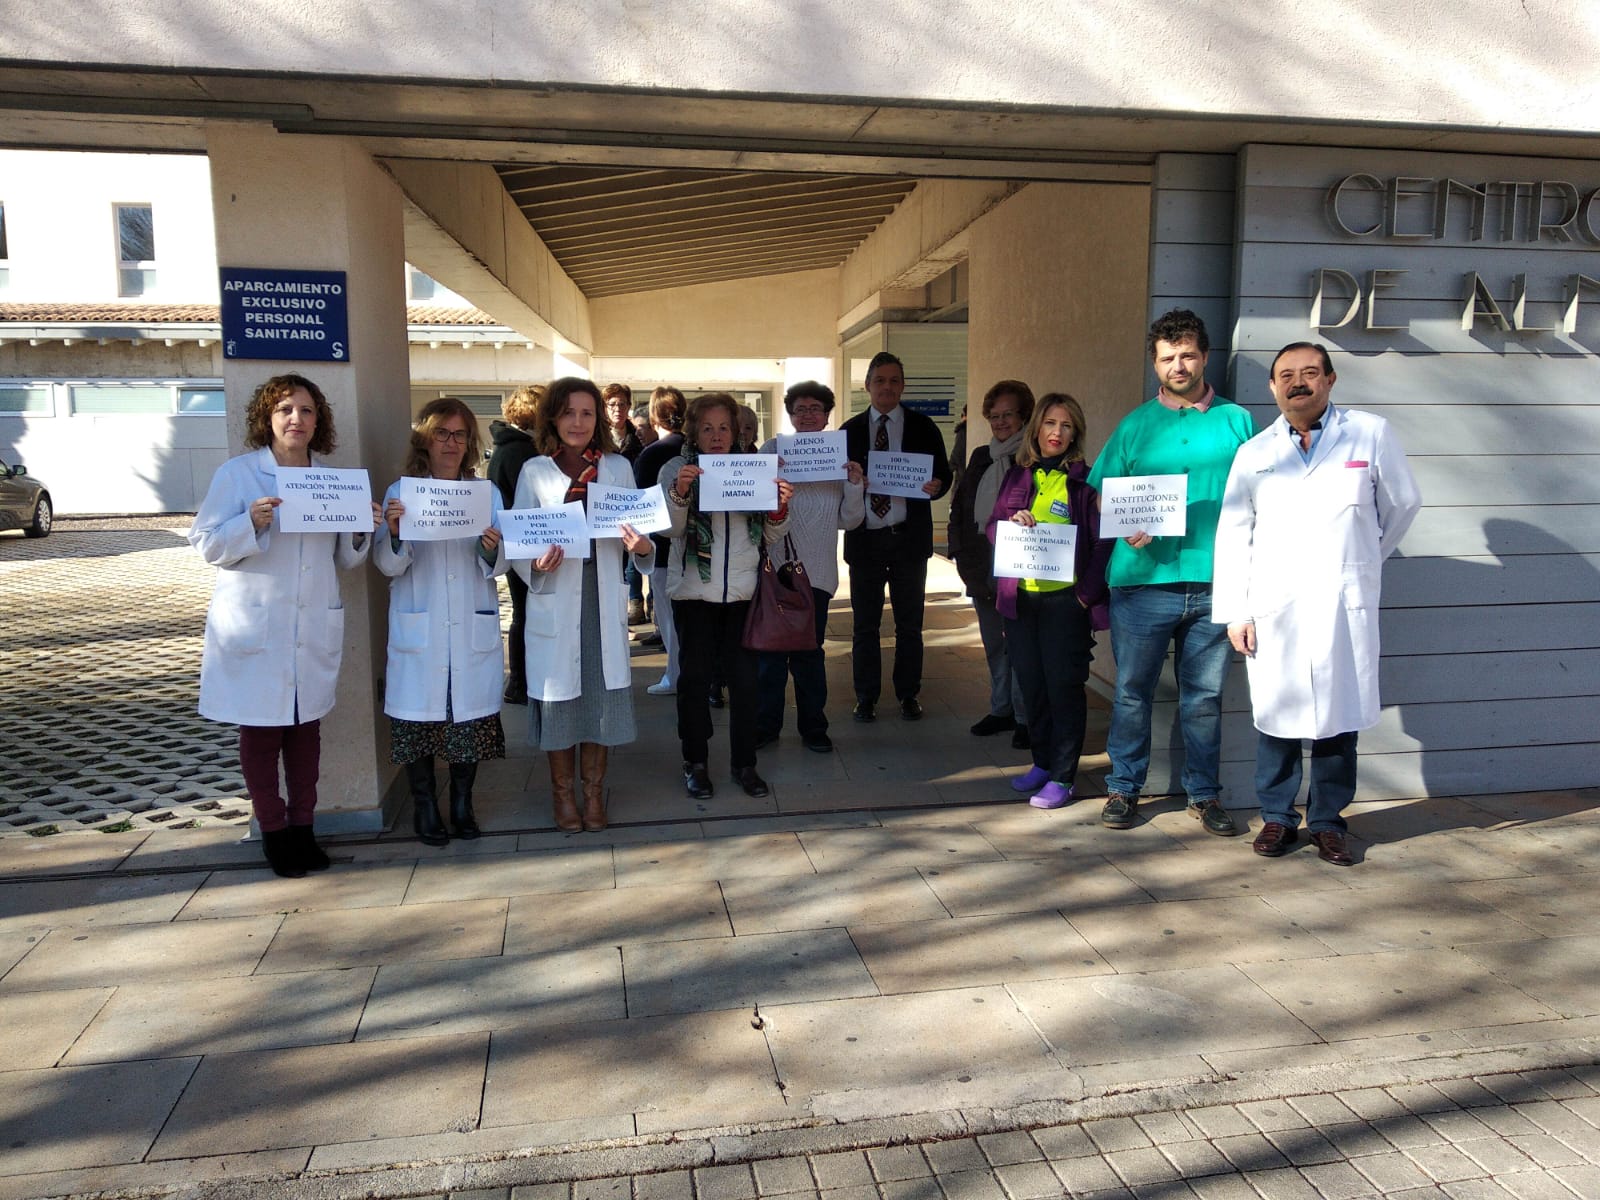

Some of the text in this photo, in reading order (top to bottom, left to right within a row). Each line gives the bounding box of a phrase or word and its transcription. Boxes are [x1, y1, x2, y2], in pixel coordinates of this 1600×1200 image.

[1328, 172, 1600, 243] CENTR
[224, 280, 342, 295] APARCAMIENTO
[1310, 268, 1411, 329] DE
[242, 297, 326, 310] EXCLUSIVO
[245, 313, 324, 325] PERSONAL
[245, 328, 326, 340] SANITARIO
[875, 464, 928, 474] SUSTITUCIONES
[285, 482, 363, 491] ATENCIÓN PRIMARIA
[881, 480, 916, 488] AUSENCIAS
[1132, 484, 1146, 492] 100
[416, 485, 472, 496] 10 MINUTOS
[722, 490, 755, 498] ¡MATAN!
[604, 491, 639, 501] ¡MENOS
[1110, 493, 1179, 504] SUSTITUCIONES
[322, 503, 328, 511] Y
[1114, 507, 1126, 515] EN
[1130, 505, 1156, 514] TODAS
[422, 509, 466, 517] PACIENTE
[527, 511, 567, 520] MINUTOS
[303, 514, 357, 522] DE CALIDAD
[1119, 516, 1164, 525] AUSENCIAS
[1037, 528, 1051, 536] UNA
[1027, 563, 1060, 571] CALIDAD
